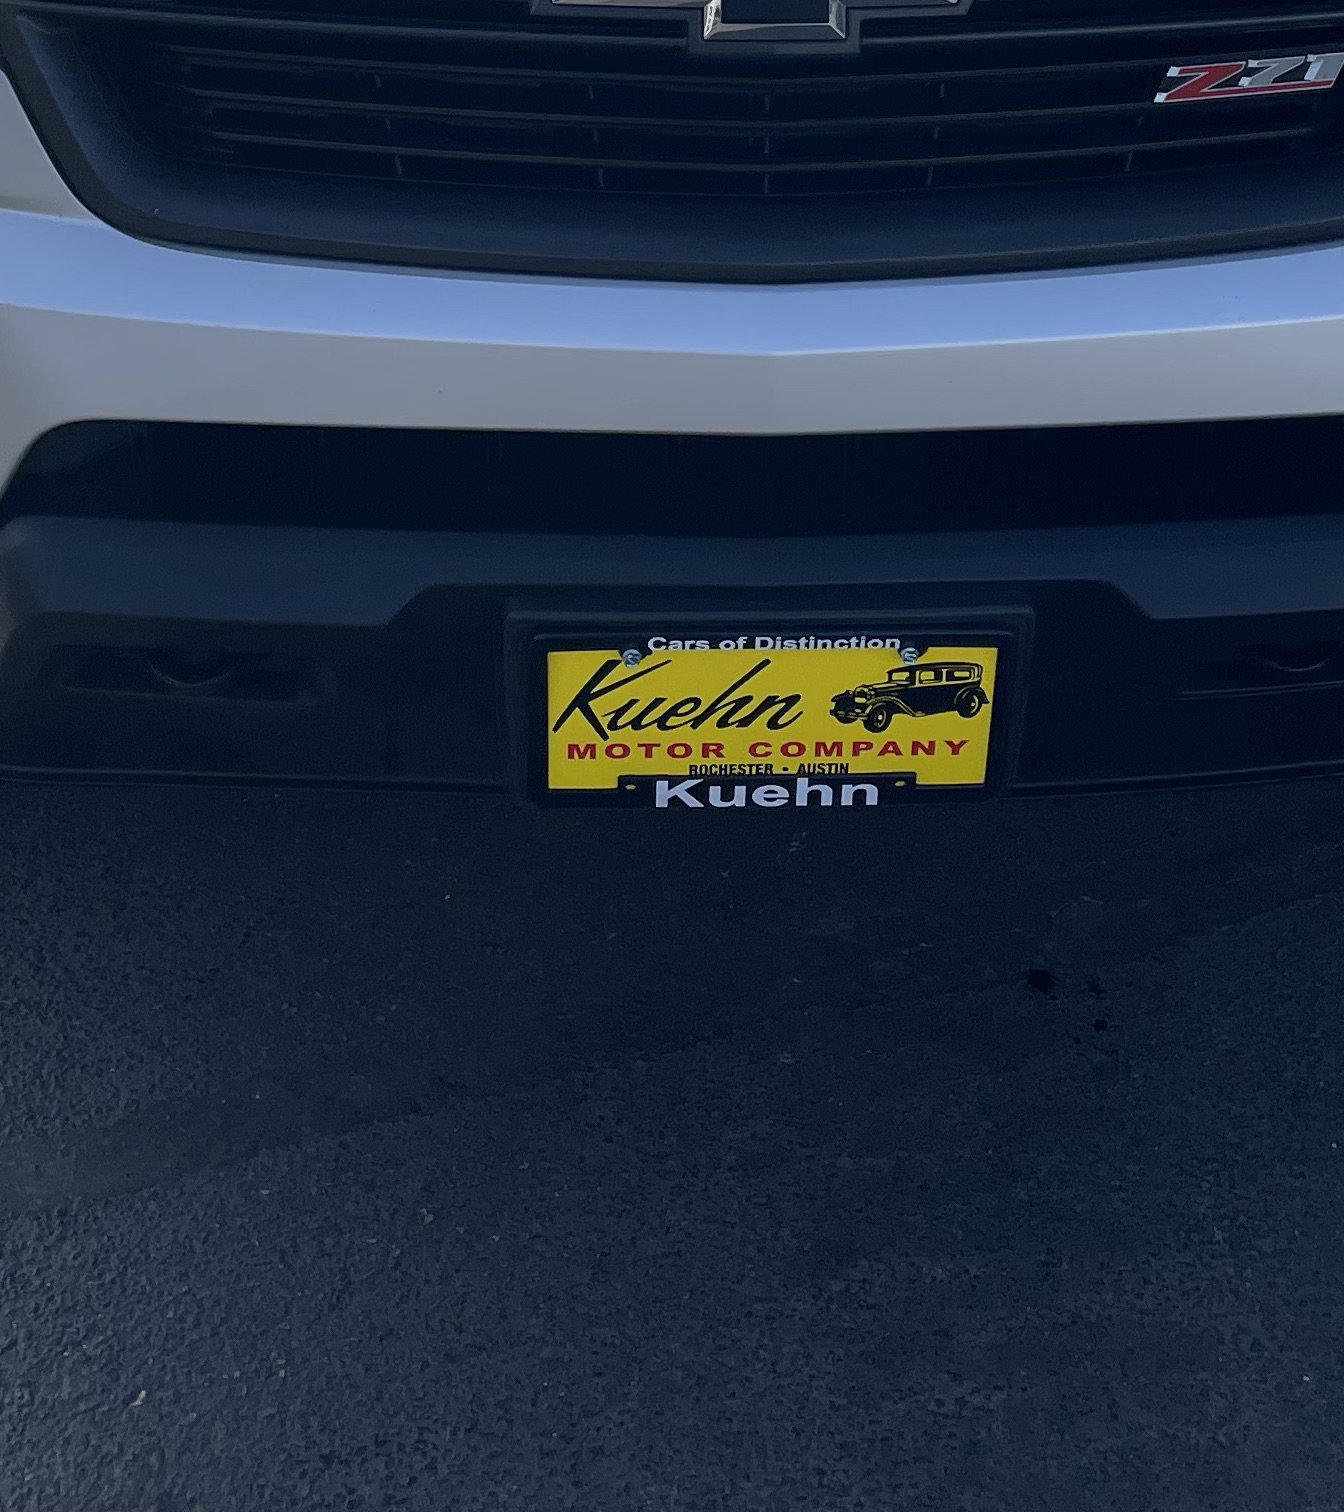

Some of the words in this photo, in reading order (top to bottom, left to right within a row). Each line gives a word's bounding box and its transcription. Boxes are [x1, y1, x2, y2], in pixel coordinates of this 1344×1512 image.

[647, 636, 711, 652] Cars
[718, 635, 750, 650] of
[755, 635, 901, 651] Distinction
[553, 658, 804, 742] Kuehn
[567, 742, 726, 760] MOTOR
[748, 739, 971, 758] COMPANY
[688, 763, 774, 776] ROCHESTER
[797, 762, 849, 775] AUSTIN
[655, 777, 879, 809] Kuehn
